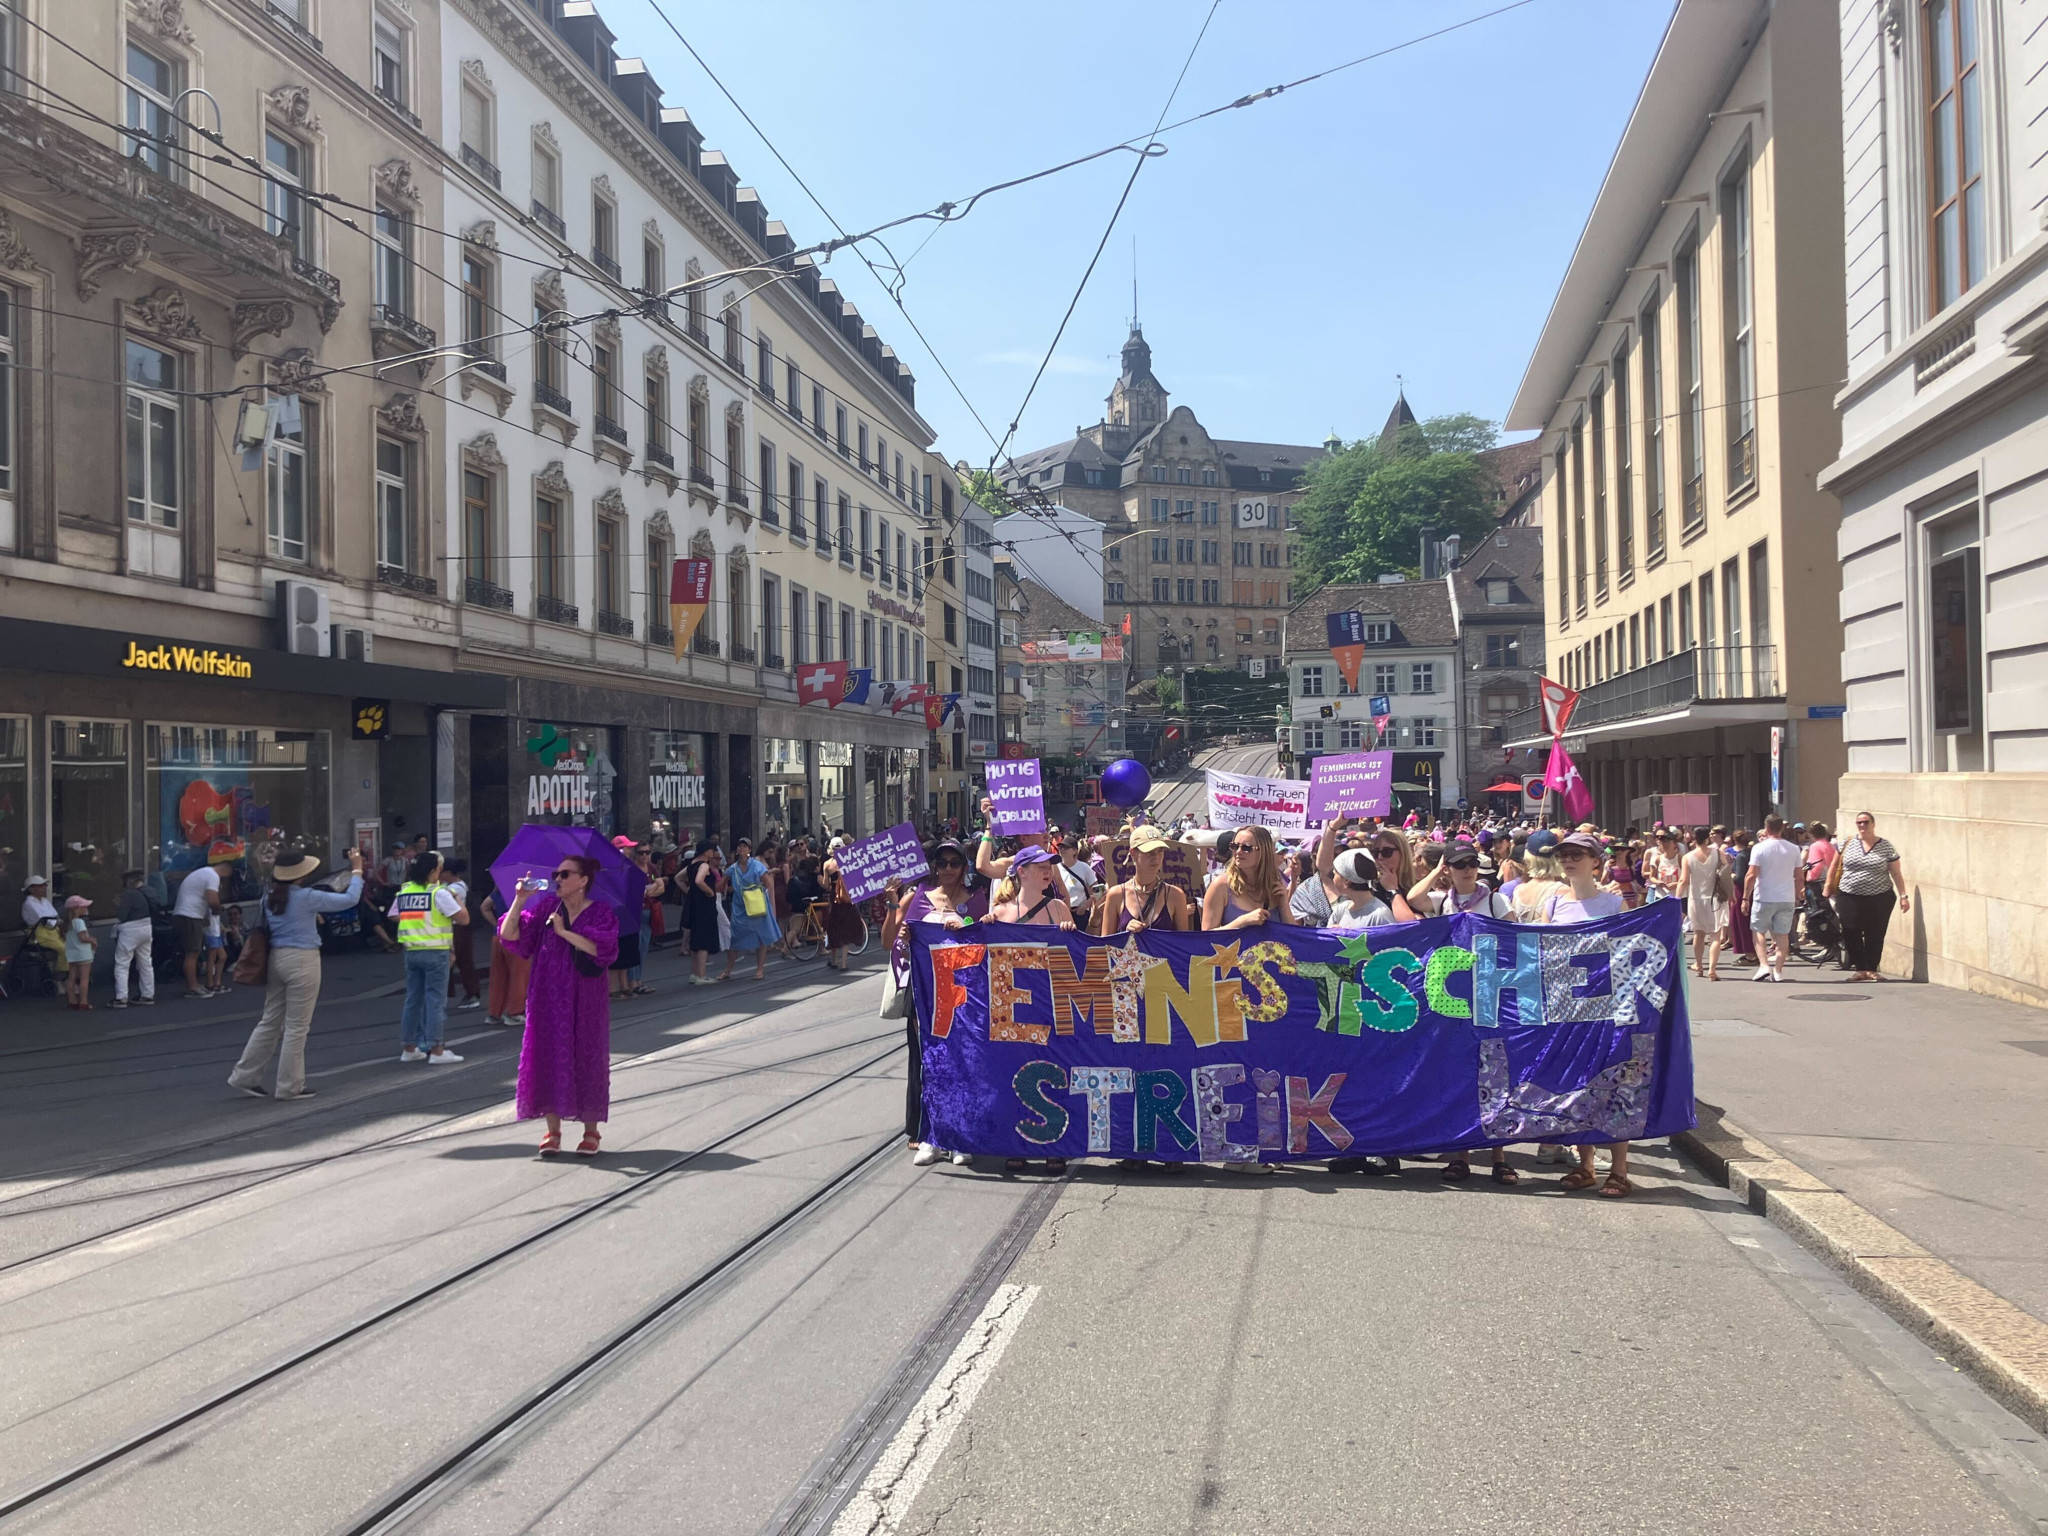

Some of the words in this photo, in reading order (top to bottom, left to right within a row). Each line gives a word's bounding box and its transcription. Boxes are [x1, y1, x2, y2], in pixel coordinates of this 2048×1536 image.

[1243, 502, 1264, 521] 30
[687, 562, 697, 583] Basel
[698, 562, 707, 574] Art
[696, 577, 706, 598] Basel
[1350, 613, 1358, 623] Art
[1351, 624, 1361, 641] Basel
[123, 641, 172, 671] Jack
[172, 646, 251, 678] Wolfskin
[1252, 661, 1262, 672] 15
[985, 762, 1035, 779] MUTIG
[1320, 761, 1366, 773] FEMINISMUS
[1369, 761, 1382, 769] IST
[1318, 771, 1381, 784] KLASSENKAMPF
[649, 775, 705, 809] APOTHEKE
[989, 783, 1042, 801] WÜTEND
[1242, 784, 1263, 796] sich
[1266, 784, 1305, 799] Frauen
[1339, 787, 1356, 796] MIT
[1214, 792, 1304, 813] verbunden
[1323, 798, 1380, 812] ZÄRTLICHKEIT
[989, 809, 1041, 824] WEIBLICH
[1215, 808, 1257, 824] entsteht
[1260, 813, 1302, 829] Freiheit
[837, 846, 863, 863] Wir
[866, 833, 893, 854] sind
[839, 853, 870, 875] nicht
[872, 848, 894, 861] hier
[895, 840, 916, 852] um
[862, 860, 888, 877] euer
[887, 852, 917, 870] Ego
